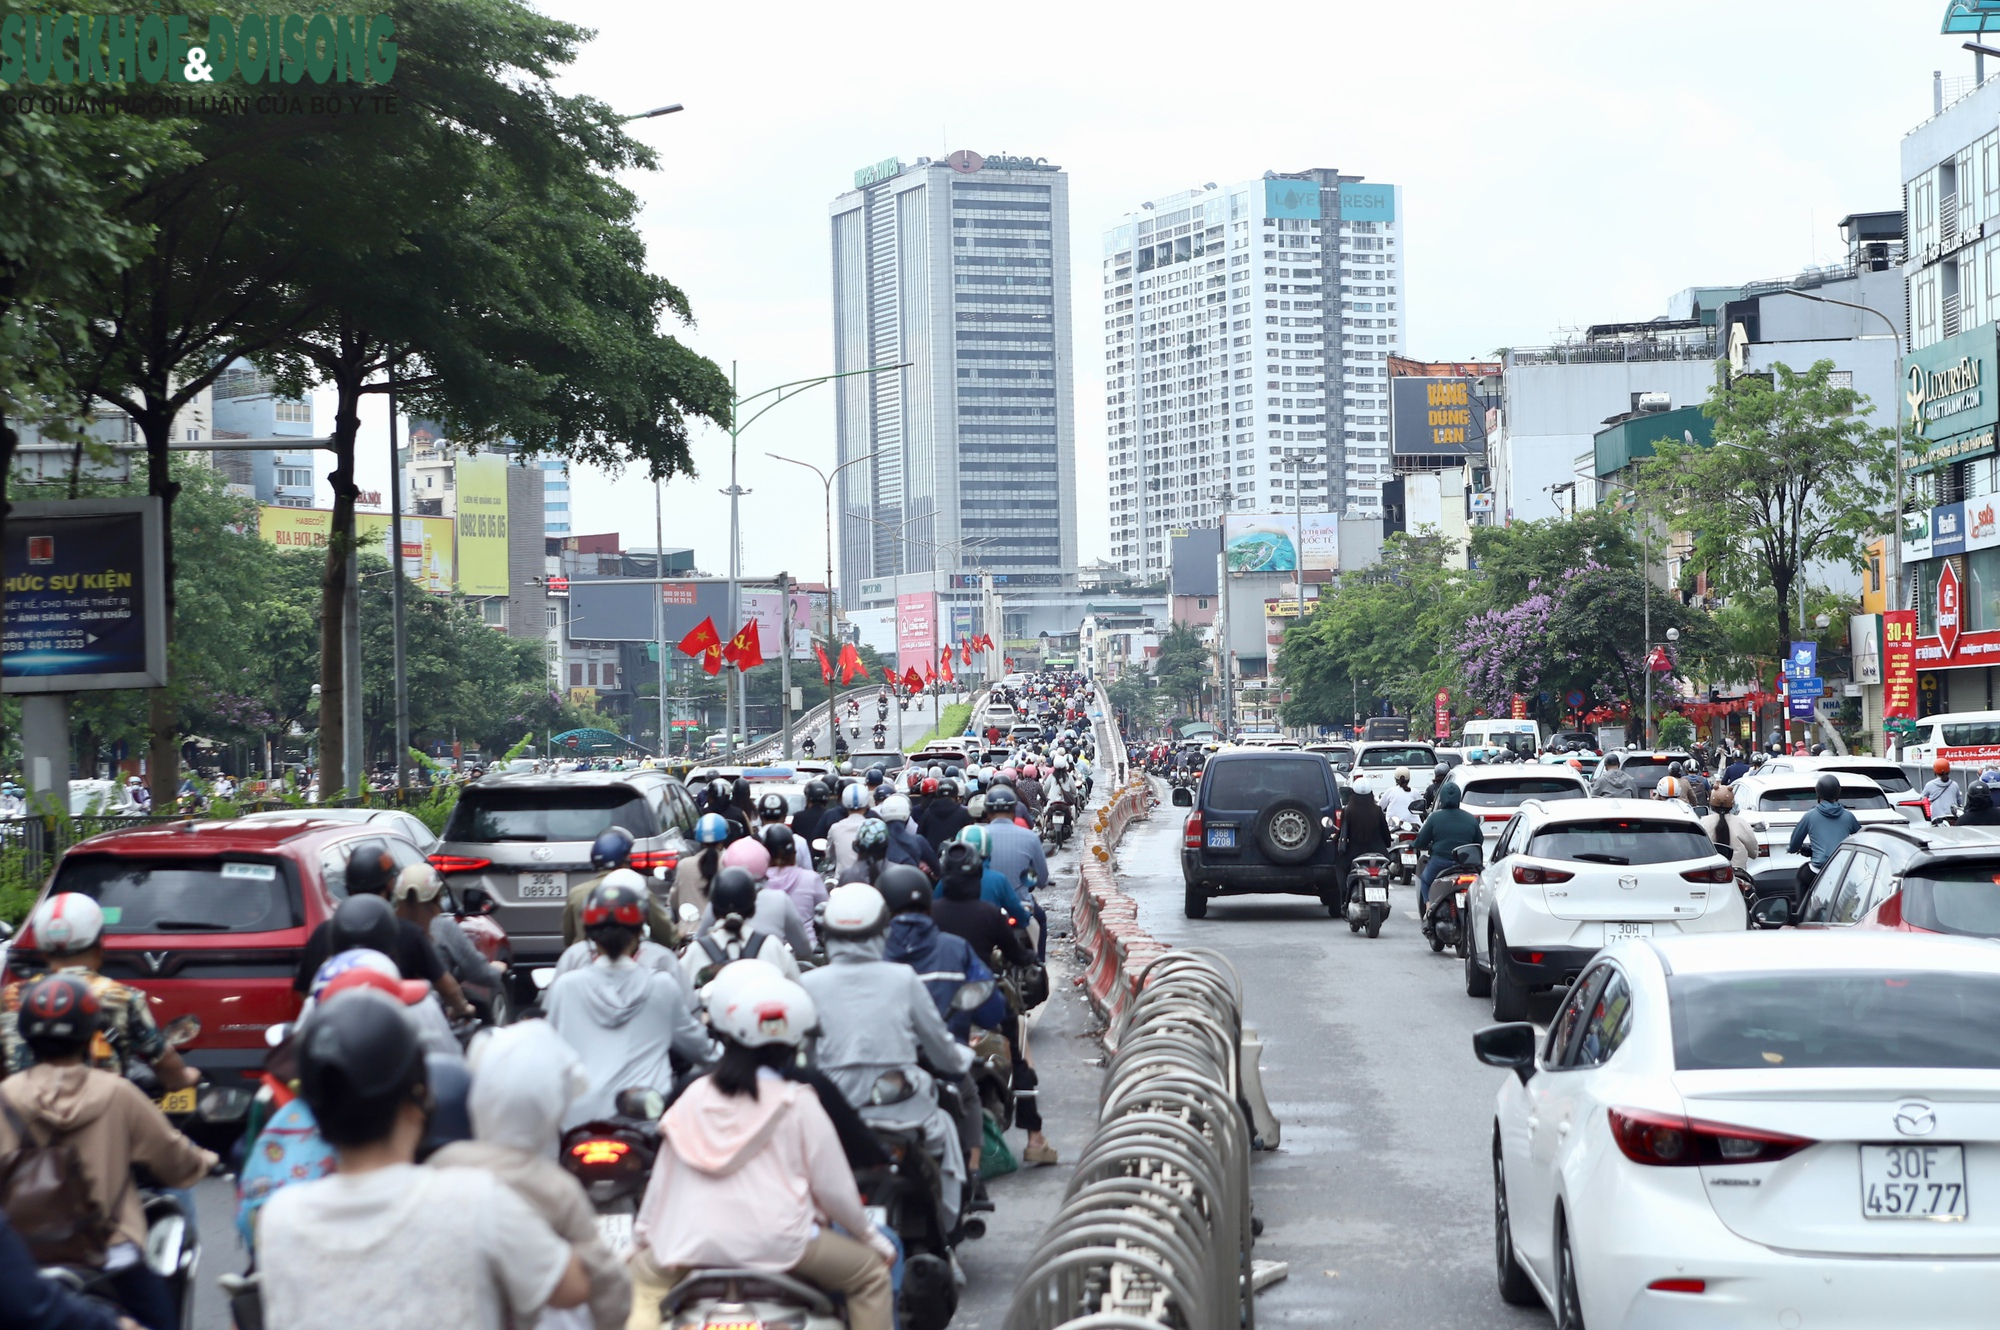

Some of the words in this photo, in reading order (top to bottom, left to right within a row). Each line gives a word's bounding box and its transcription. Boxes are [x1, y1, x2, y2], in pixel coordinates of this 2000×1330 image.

[986, 151, 1048, 175] mipec
[1963, 224, 1981, 246] HOME
[1433, 428, 1465, 444] LAN
[296, 517, 320, 526] HABECO
[460, 513, 477, 537] 0982
[478, 514, 486, 537] 05
[488, 514, 496, 538] 05
[498, 514, 506, 538] 05
[276, 530, 291, 545] BIA
[4, 573, 44, 592] HỨC
[50, 572, 79, 594] SỰ
[84, 569, 132, 592] KIỆN
[42, 600, 62, 608] CHO
[80, 610, 101, 621] SÂN
[103, 608, 131, 620] KHẤU
[66, 627, 84, 638] CÁO
[2, 641, 24, 652] 098
[28, 640, 52, 650] 404
[55, 639, 85, 649] 3333
[1214, 829, 1229, 838] 36B
[1211, 837, 1231, 846] 2708
[1618, 923, 1639, 934] 30H
[1886, 1148, 1939, 1179] 30F
[1866, 1183, 1961, 1213] 457.77
